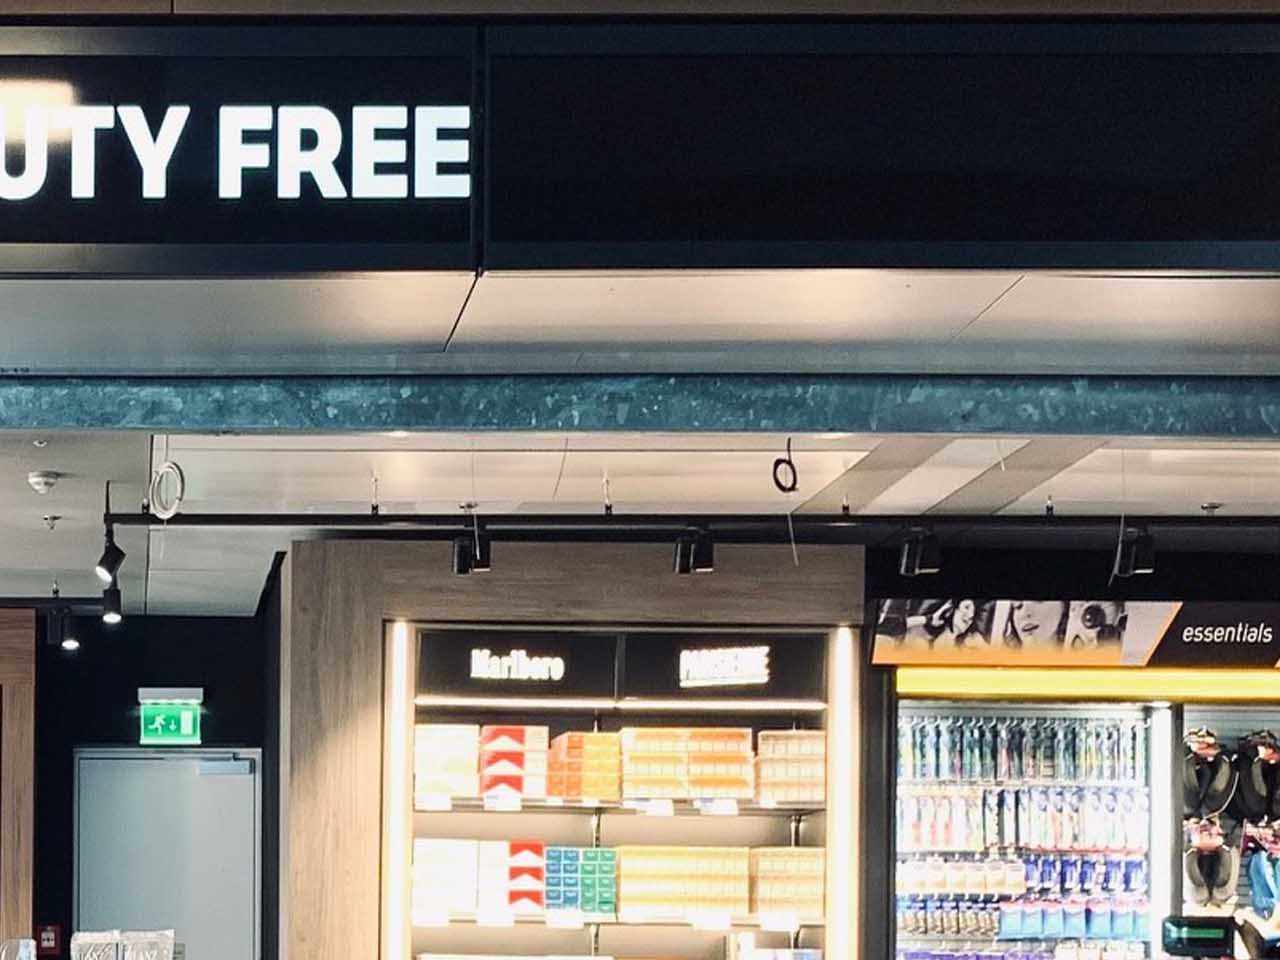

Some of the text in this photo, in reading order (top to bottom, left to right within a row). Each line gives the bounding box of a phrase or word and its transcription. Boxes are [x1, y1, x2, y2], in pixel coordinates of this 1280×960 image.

[218, 105, 471, 199] FREE
[1182, 622, 1273, 644] essentials
[470, 648, 565, 681] Marlboro
